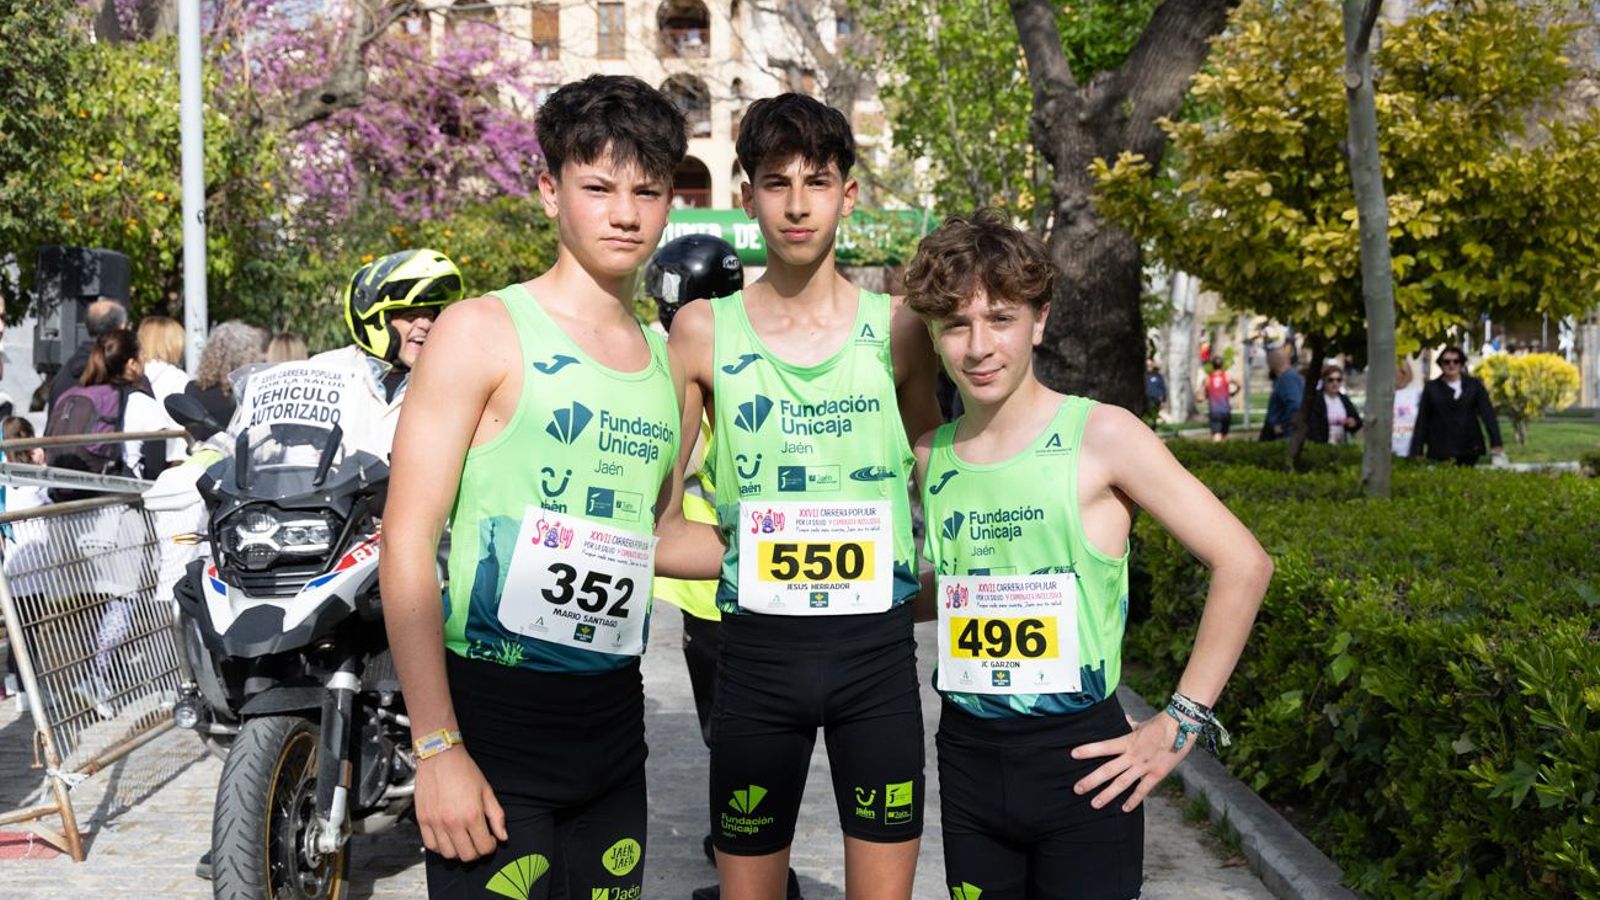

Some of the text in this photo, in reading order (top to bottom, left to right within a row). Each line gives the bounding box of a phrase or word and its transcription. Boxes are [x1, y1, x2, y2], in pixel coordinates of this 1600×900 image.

[732, 223, 762, 250] DE
[250, 403, 341, 426] AUTORIZADO
[781, 395, 880, 418] Fundación
[600, 410, 674, 445] Fundación
[781, 415, 852, 438] Unicaja
[599, 432, 659, 464] Unicaja
[781, 441, 814, 454] Jaén
[594, 460, 624, 476] Jaén
[820, 508, 848, 517] CARRERA
[848, 508, 877, 516] POPULAR
[969, 506, 1044, 525] Fundación
[970, 523, 1022, 542] Unicaja
[971, 546, 996, 556] Jaén
[770, 543, 864, 580] 550
[541, 562, 634, 618] 352
[811, 582, 850, 590] HERRADOR
[996, 582, 1024, 592] CARRERA
[1025, 581, 1057, 591] POPULAR
[553, 608, 618, 628] MARIO SANTIAGO
[958, 618, 1047, 658] 496
[721, 821, 759, 835] Unicaja
[722, 812, 774, 826] Fundación
